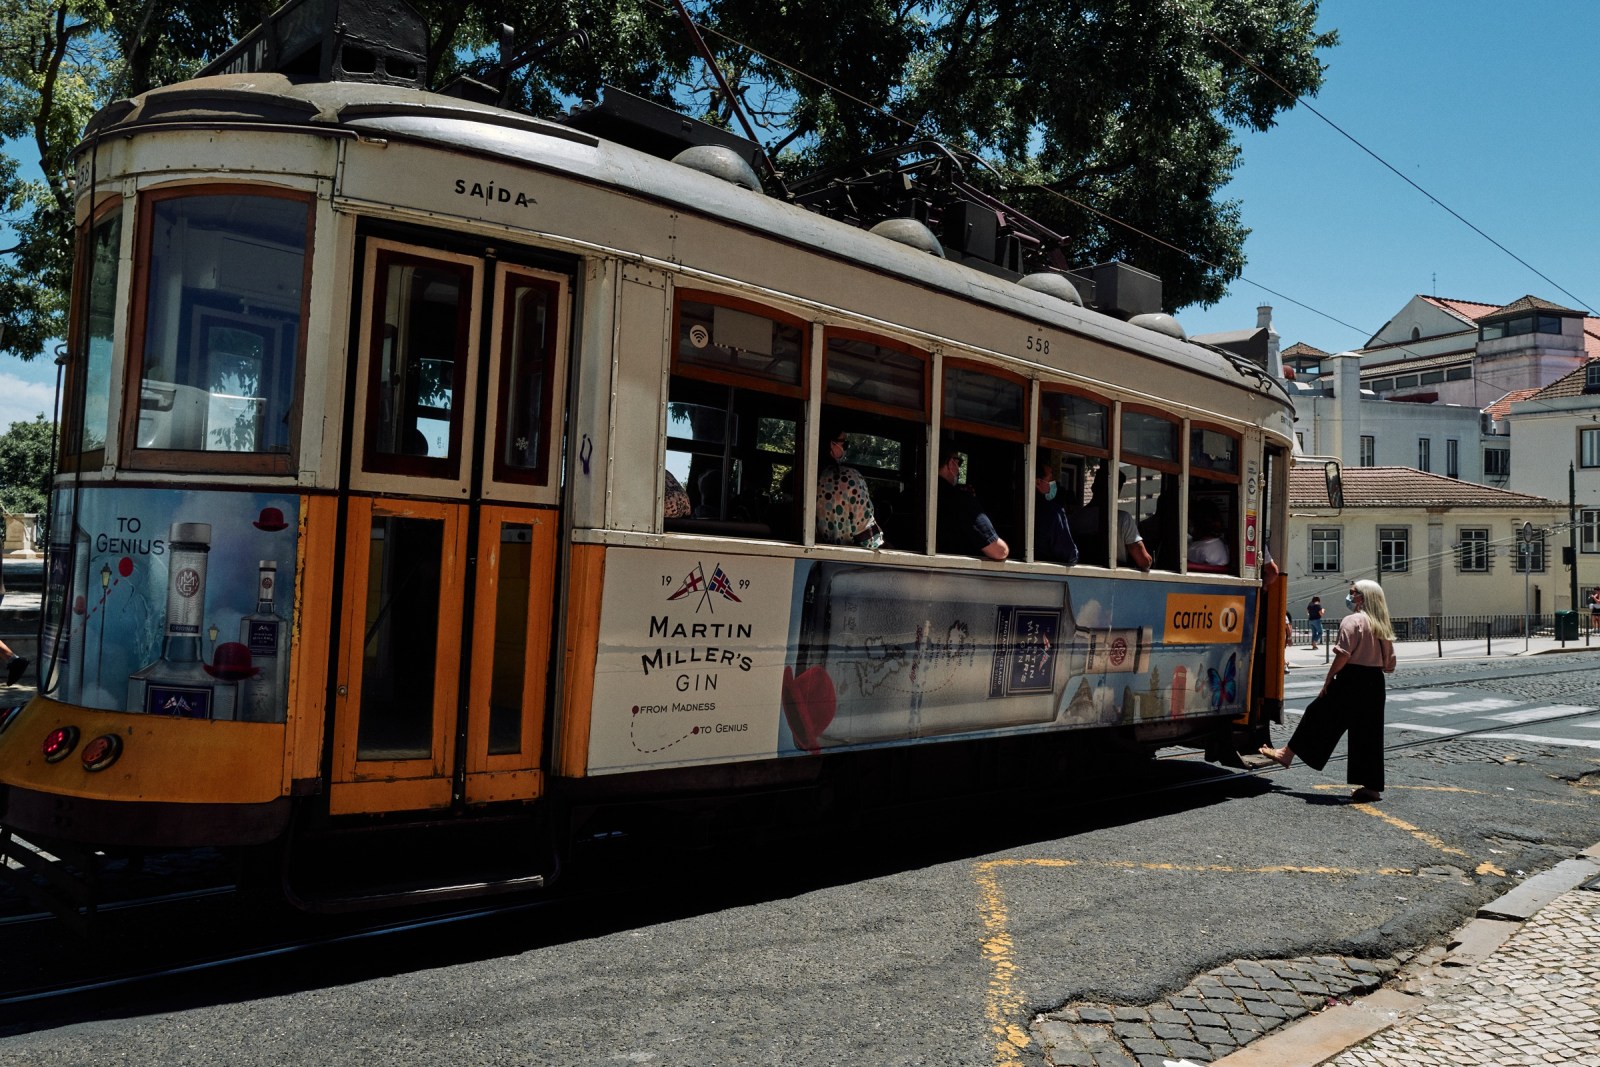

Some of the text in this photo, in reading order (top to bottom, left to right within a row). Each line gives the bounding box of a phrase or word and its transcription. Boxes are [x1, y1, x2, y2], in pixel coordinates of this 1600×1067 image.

[454, 179, 528, 208] SAÍDA
[1026, 335, 1050, 355] 558
[116, 517, 142, 534] TO
[96, 533, 165, 556] GENIUS
[661, 575, 751, 590] 19 99
[649, 615, 753, 638] MARTIN
[1173, 604, 1213, 629] carris
[641, 647, 753, 675] MILLER'S
[675, 673, 718, 692] GIN
[640, 702, 716, 714] FROM MADNESS
[700, 723, 749, 734] TO GENIUS
